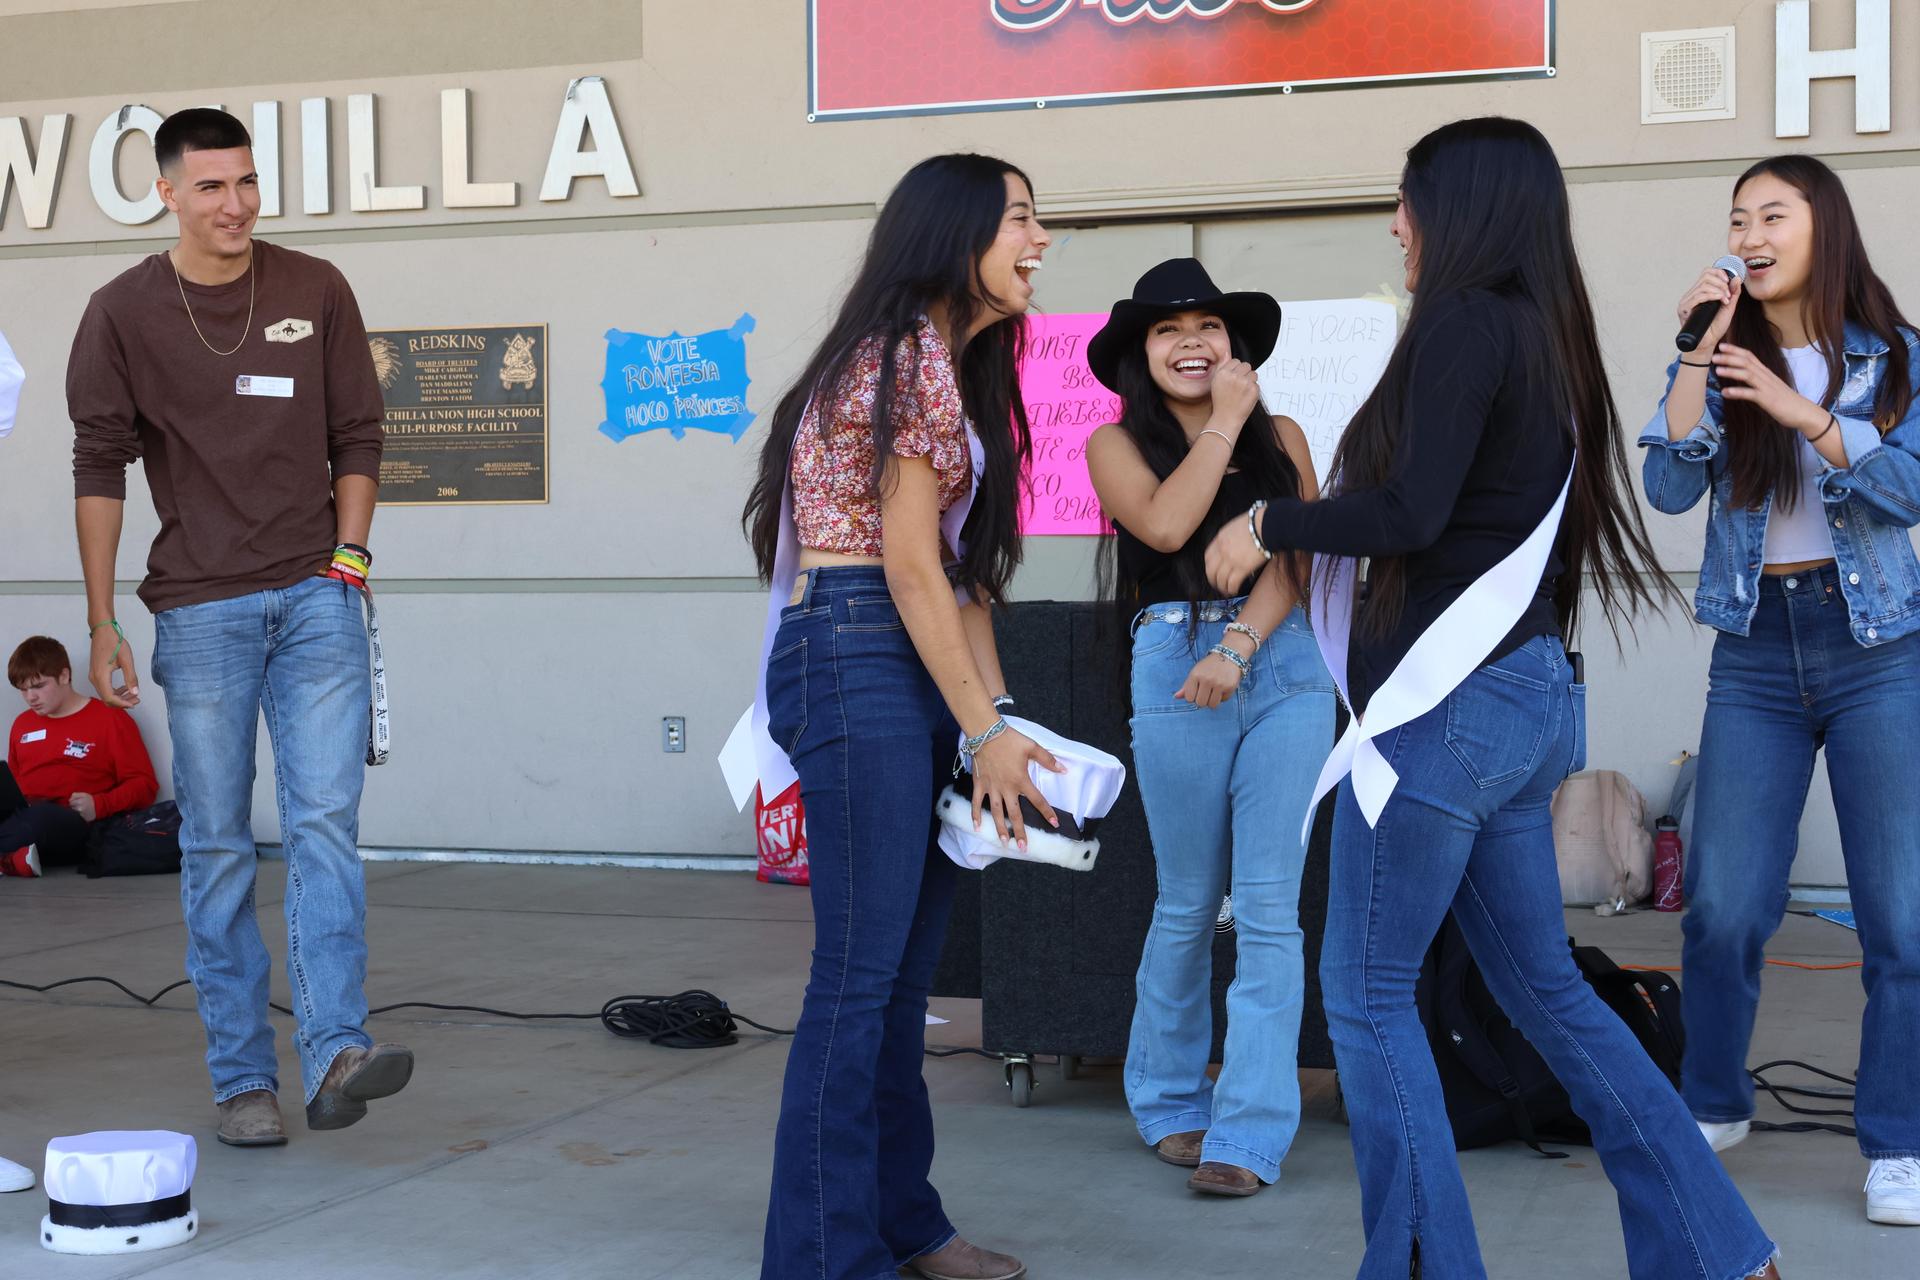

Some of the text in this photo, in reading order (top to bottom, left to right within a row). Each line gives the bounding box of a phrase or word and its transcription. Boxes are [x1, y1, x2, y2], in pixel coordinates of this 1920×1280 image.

[408, 334, 487, 352] REDSKINS
[647, 337, 700, 366] VOTE
[1062, 365, 1095, 389] BE
[1266, 354, 1360, 384] READING
[384, 408, 543, 421] CHILLA UNION HIGH SCHOOL
[625, 394, 745, 428] HOCO PRINCESS
[467, 421, 519, 432] FACILITY
[437, 487, 459, 497] 2006
[1054, 496, 1101, 521] QUE
